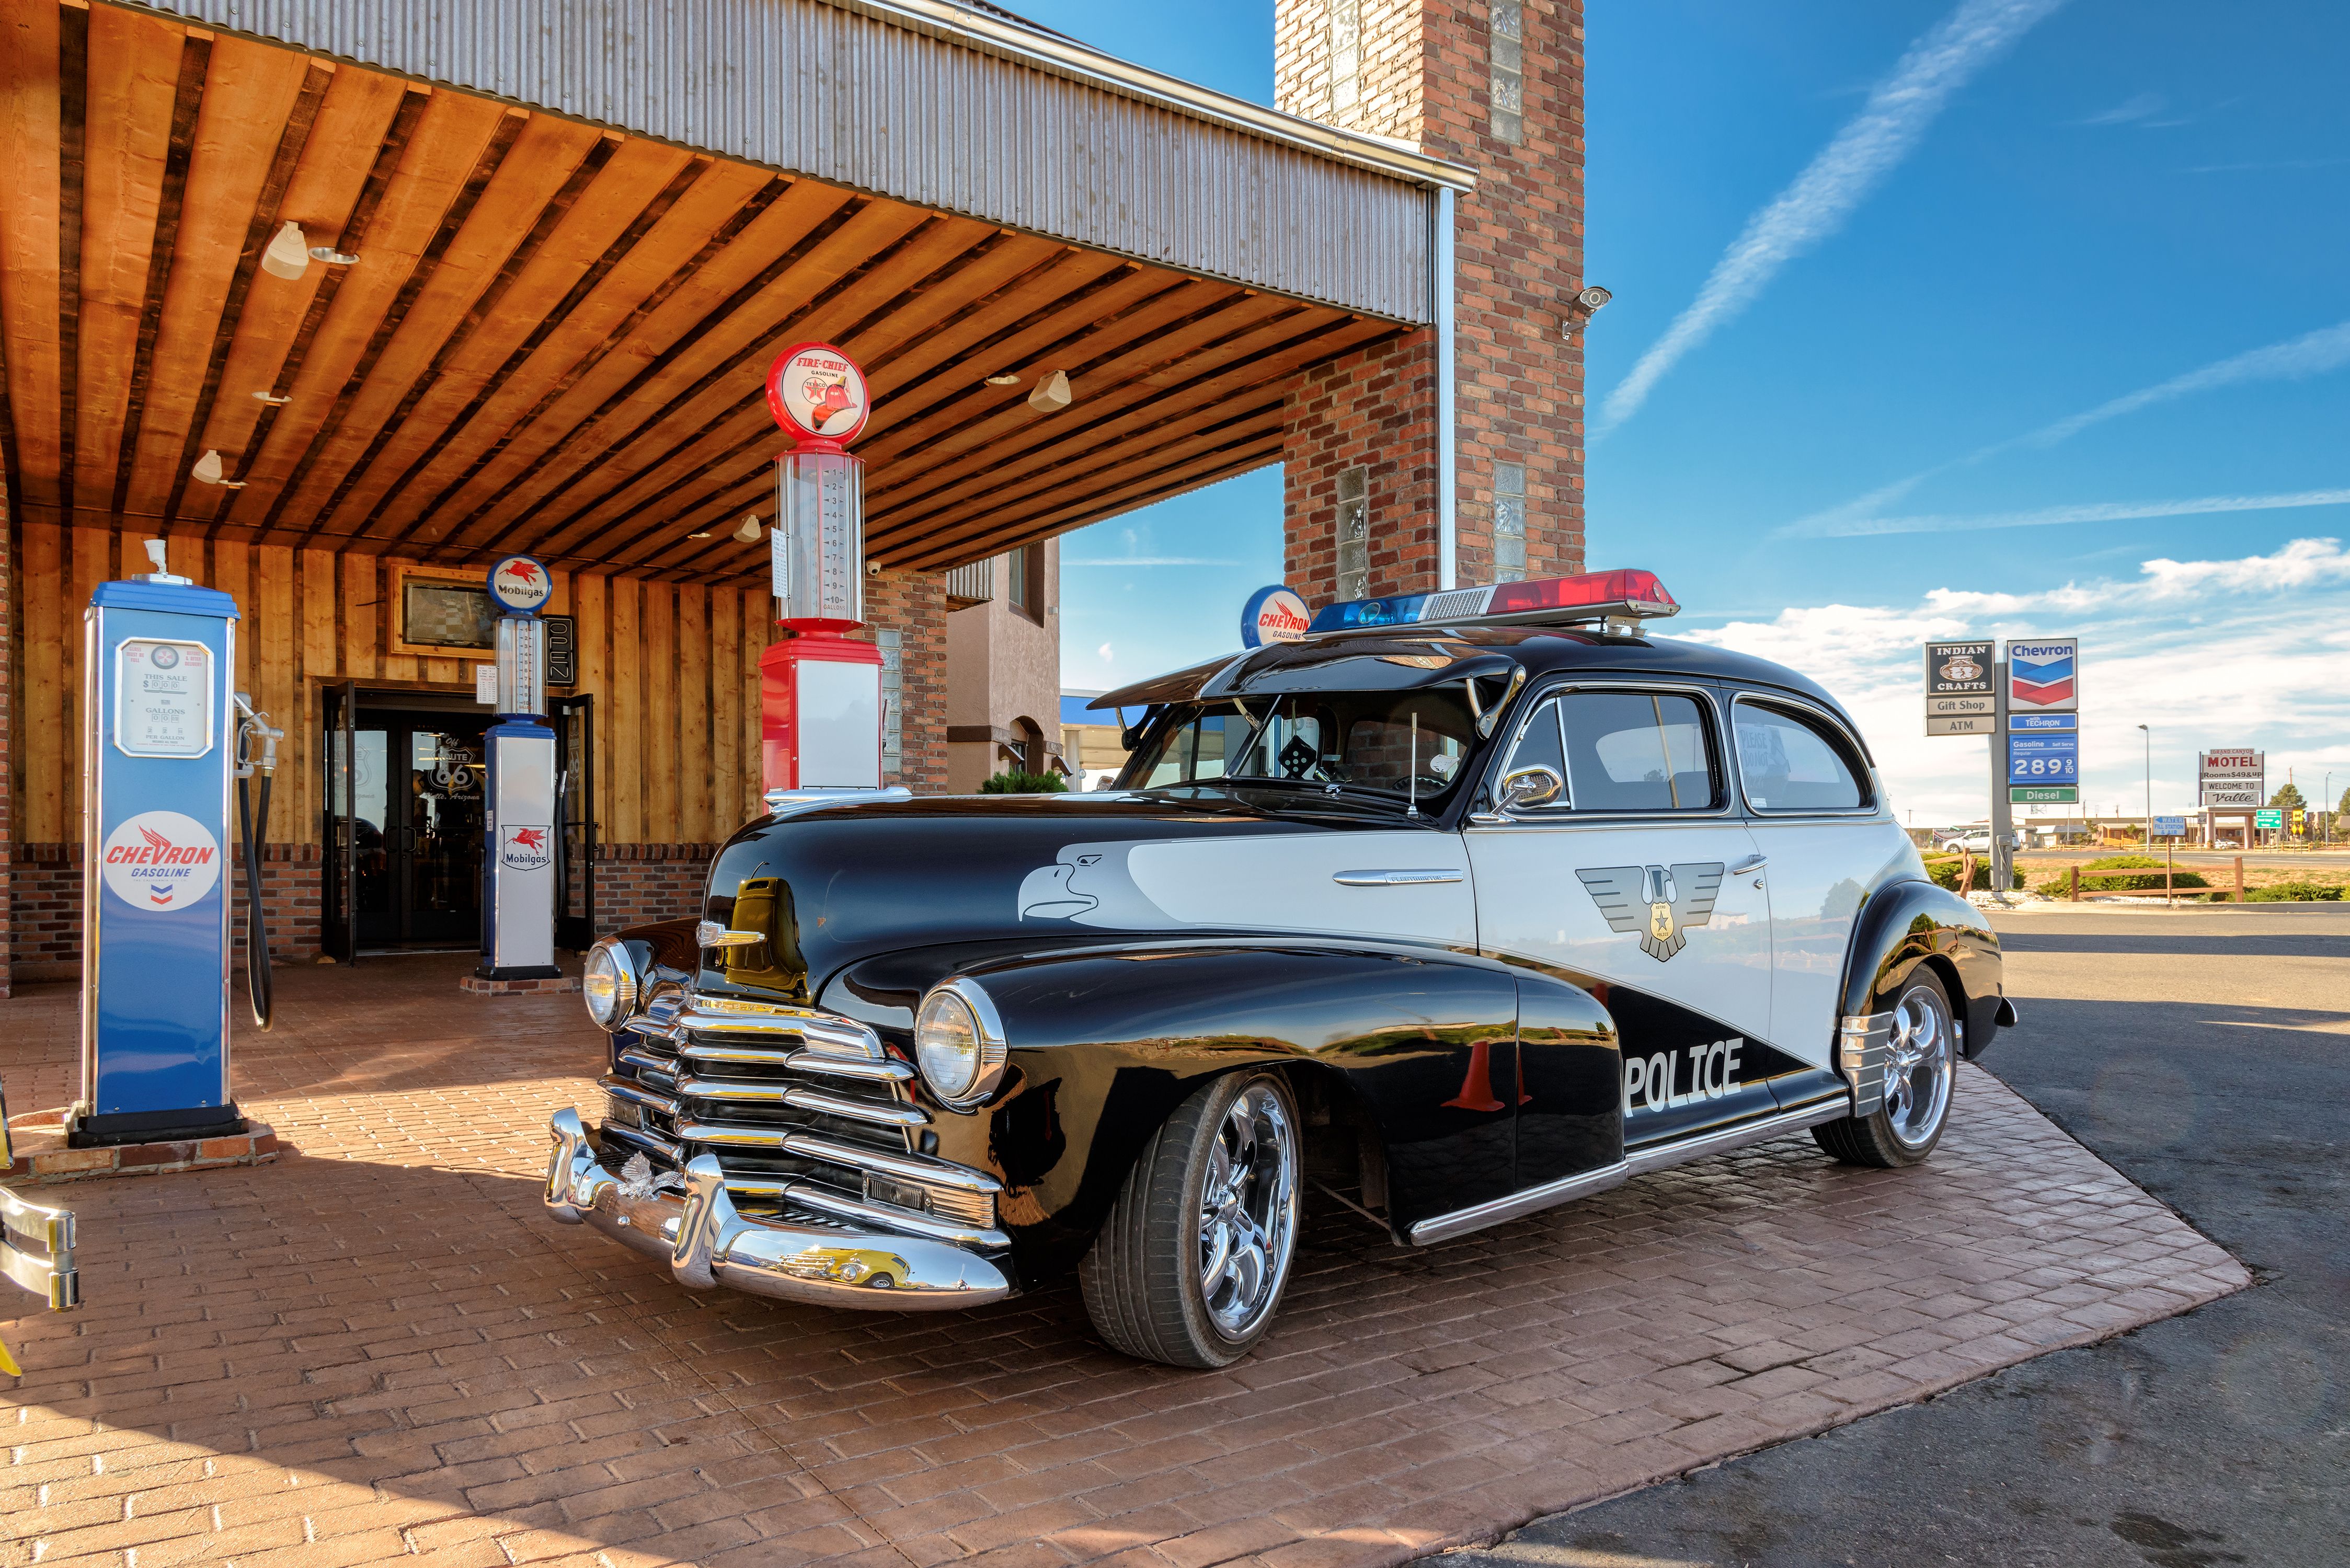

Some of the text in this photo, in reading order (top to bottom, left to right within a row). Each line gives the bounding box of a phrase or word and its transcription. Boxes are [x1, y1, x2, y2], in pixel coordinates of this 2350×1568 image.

[796, 358, 849, 372] FIRE-CHIEF
[499, 585, 543, 598] Mobilgas
[1259, 605, 1310, 631] CHEVRON
[1273, 630, 1301, 640] GASOLINE
[549, 623, 569, 678] OPEN
[1937, 646, 1986, 655] INDIAN
[2012, 645, 2073, 656] Chevron
[1937, 682, 1986, 690] CRAFTS
[1938, 700, 1985, 711] Gift Shop
[1950, 721, 1973, 730] ATM
[445, 737, 459, 746] Off
[2208, 756, 2257, 767] MOTEL
[437, 764, 468, 784] 66
[450, 793, 480, 801] Arizona
[2026, 790, 2059, 800] Diesel
[106, 835, 214, 864] CHEVRON
[506, 854, 546, 865] Mobilgas
[131, 868, 192, 877] GASOLINE
[1624, 1037, 1743, 1118] POLICE
